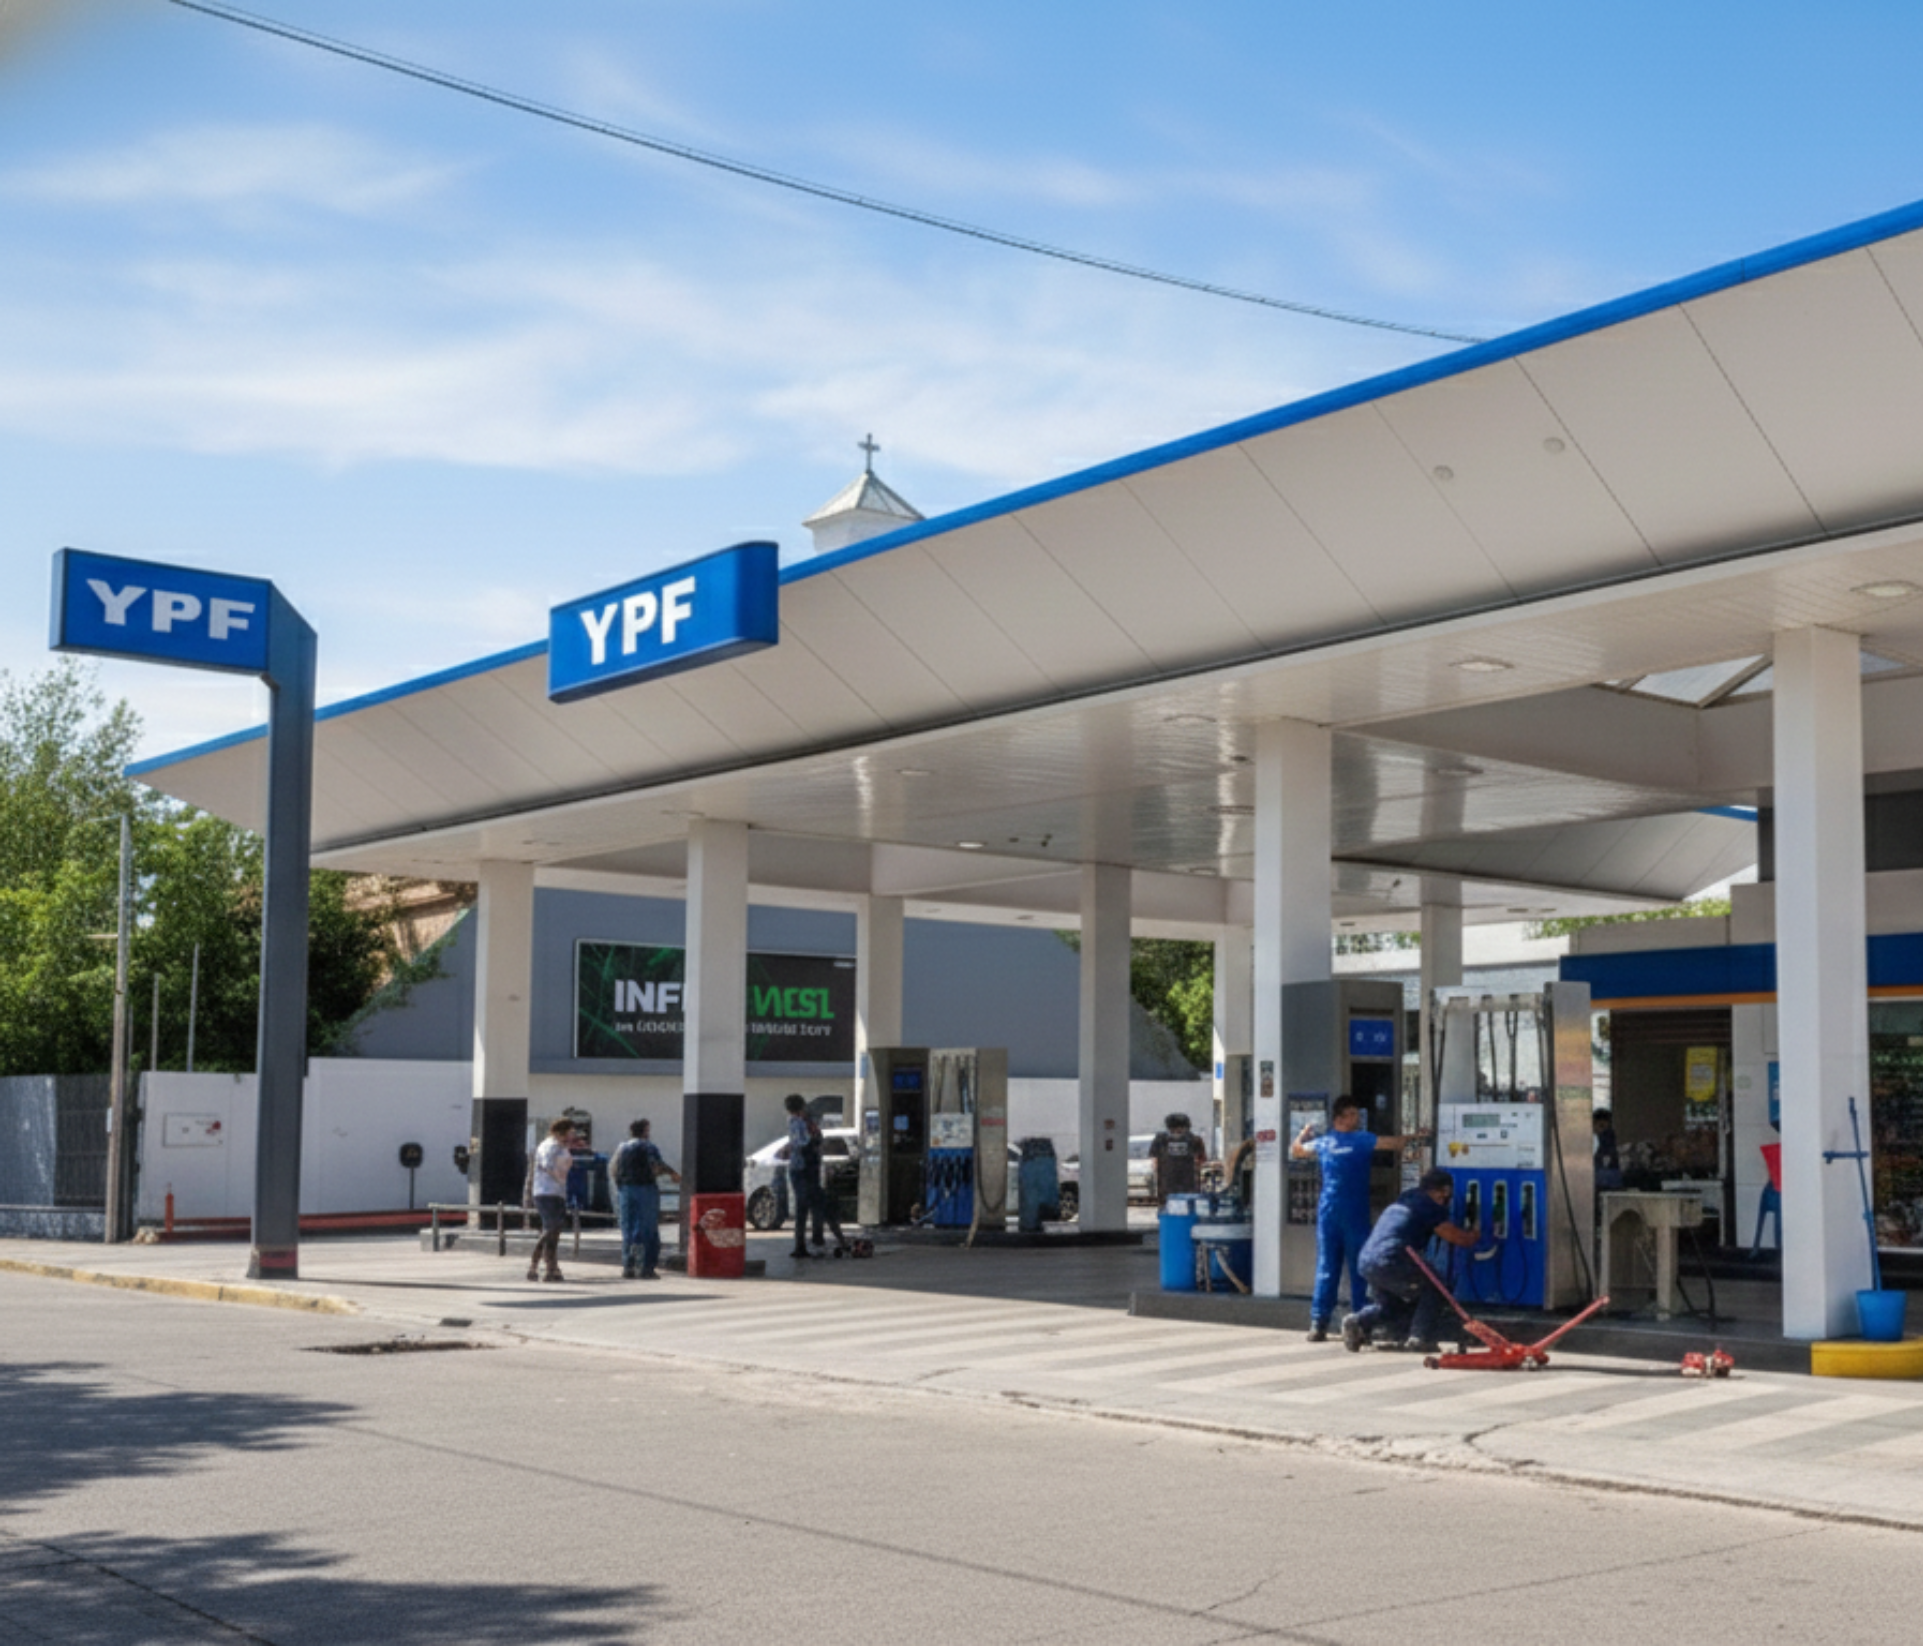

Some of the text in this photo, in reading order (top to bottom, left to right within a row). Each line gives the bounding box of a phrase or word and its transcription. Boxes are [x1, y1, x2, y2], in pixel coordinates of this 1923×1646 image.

[86, 578, 255, 640] YPF
[580, 576, 695, 665] YPF
[614, 979, 685, 1013] INF
